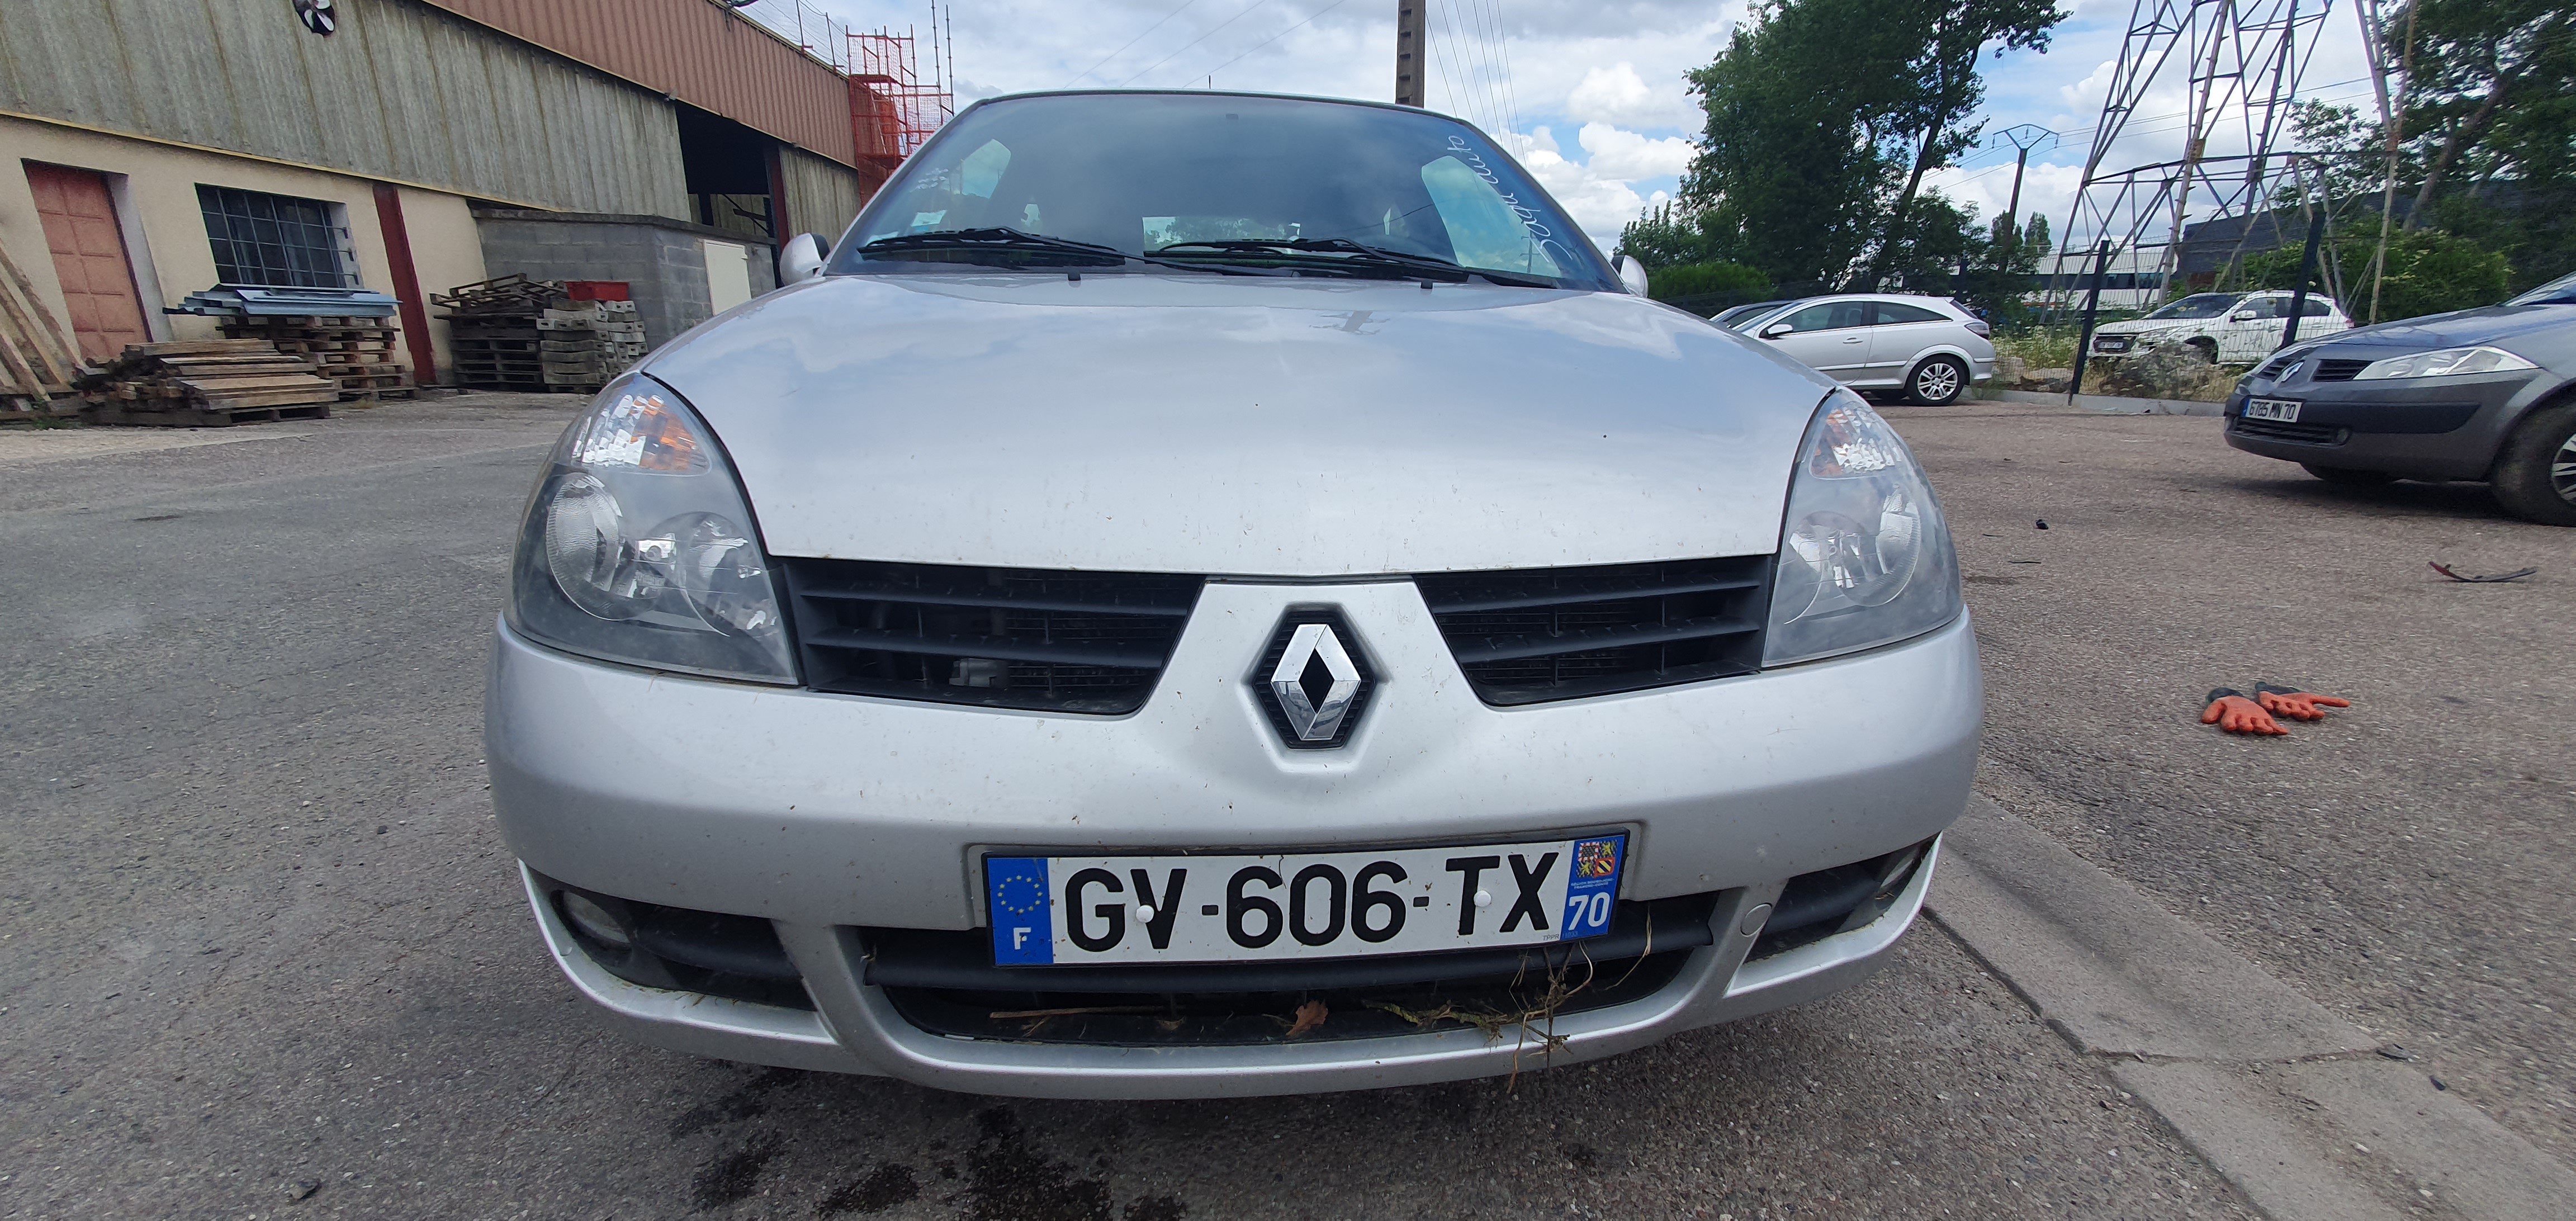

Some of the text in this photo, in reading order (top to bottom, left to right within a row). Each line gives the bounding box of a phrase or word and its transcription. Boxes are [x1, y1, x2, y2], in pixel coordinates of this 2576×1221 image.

[2284, 404, 2296, 419] 70
[1065, 851, 1559, 952] GV-606-TX
[1569, 892, 1610, 930] 70
[1014, 927, 1031, 950] F
